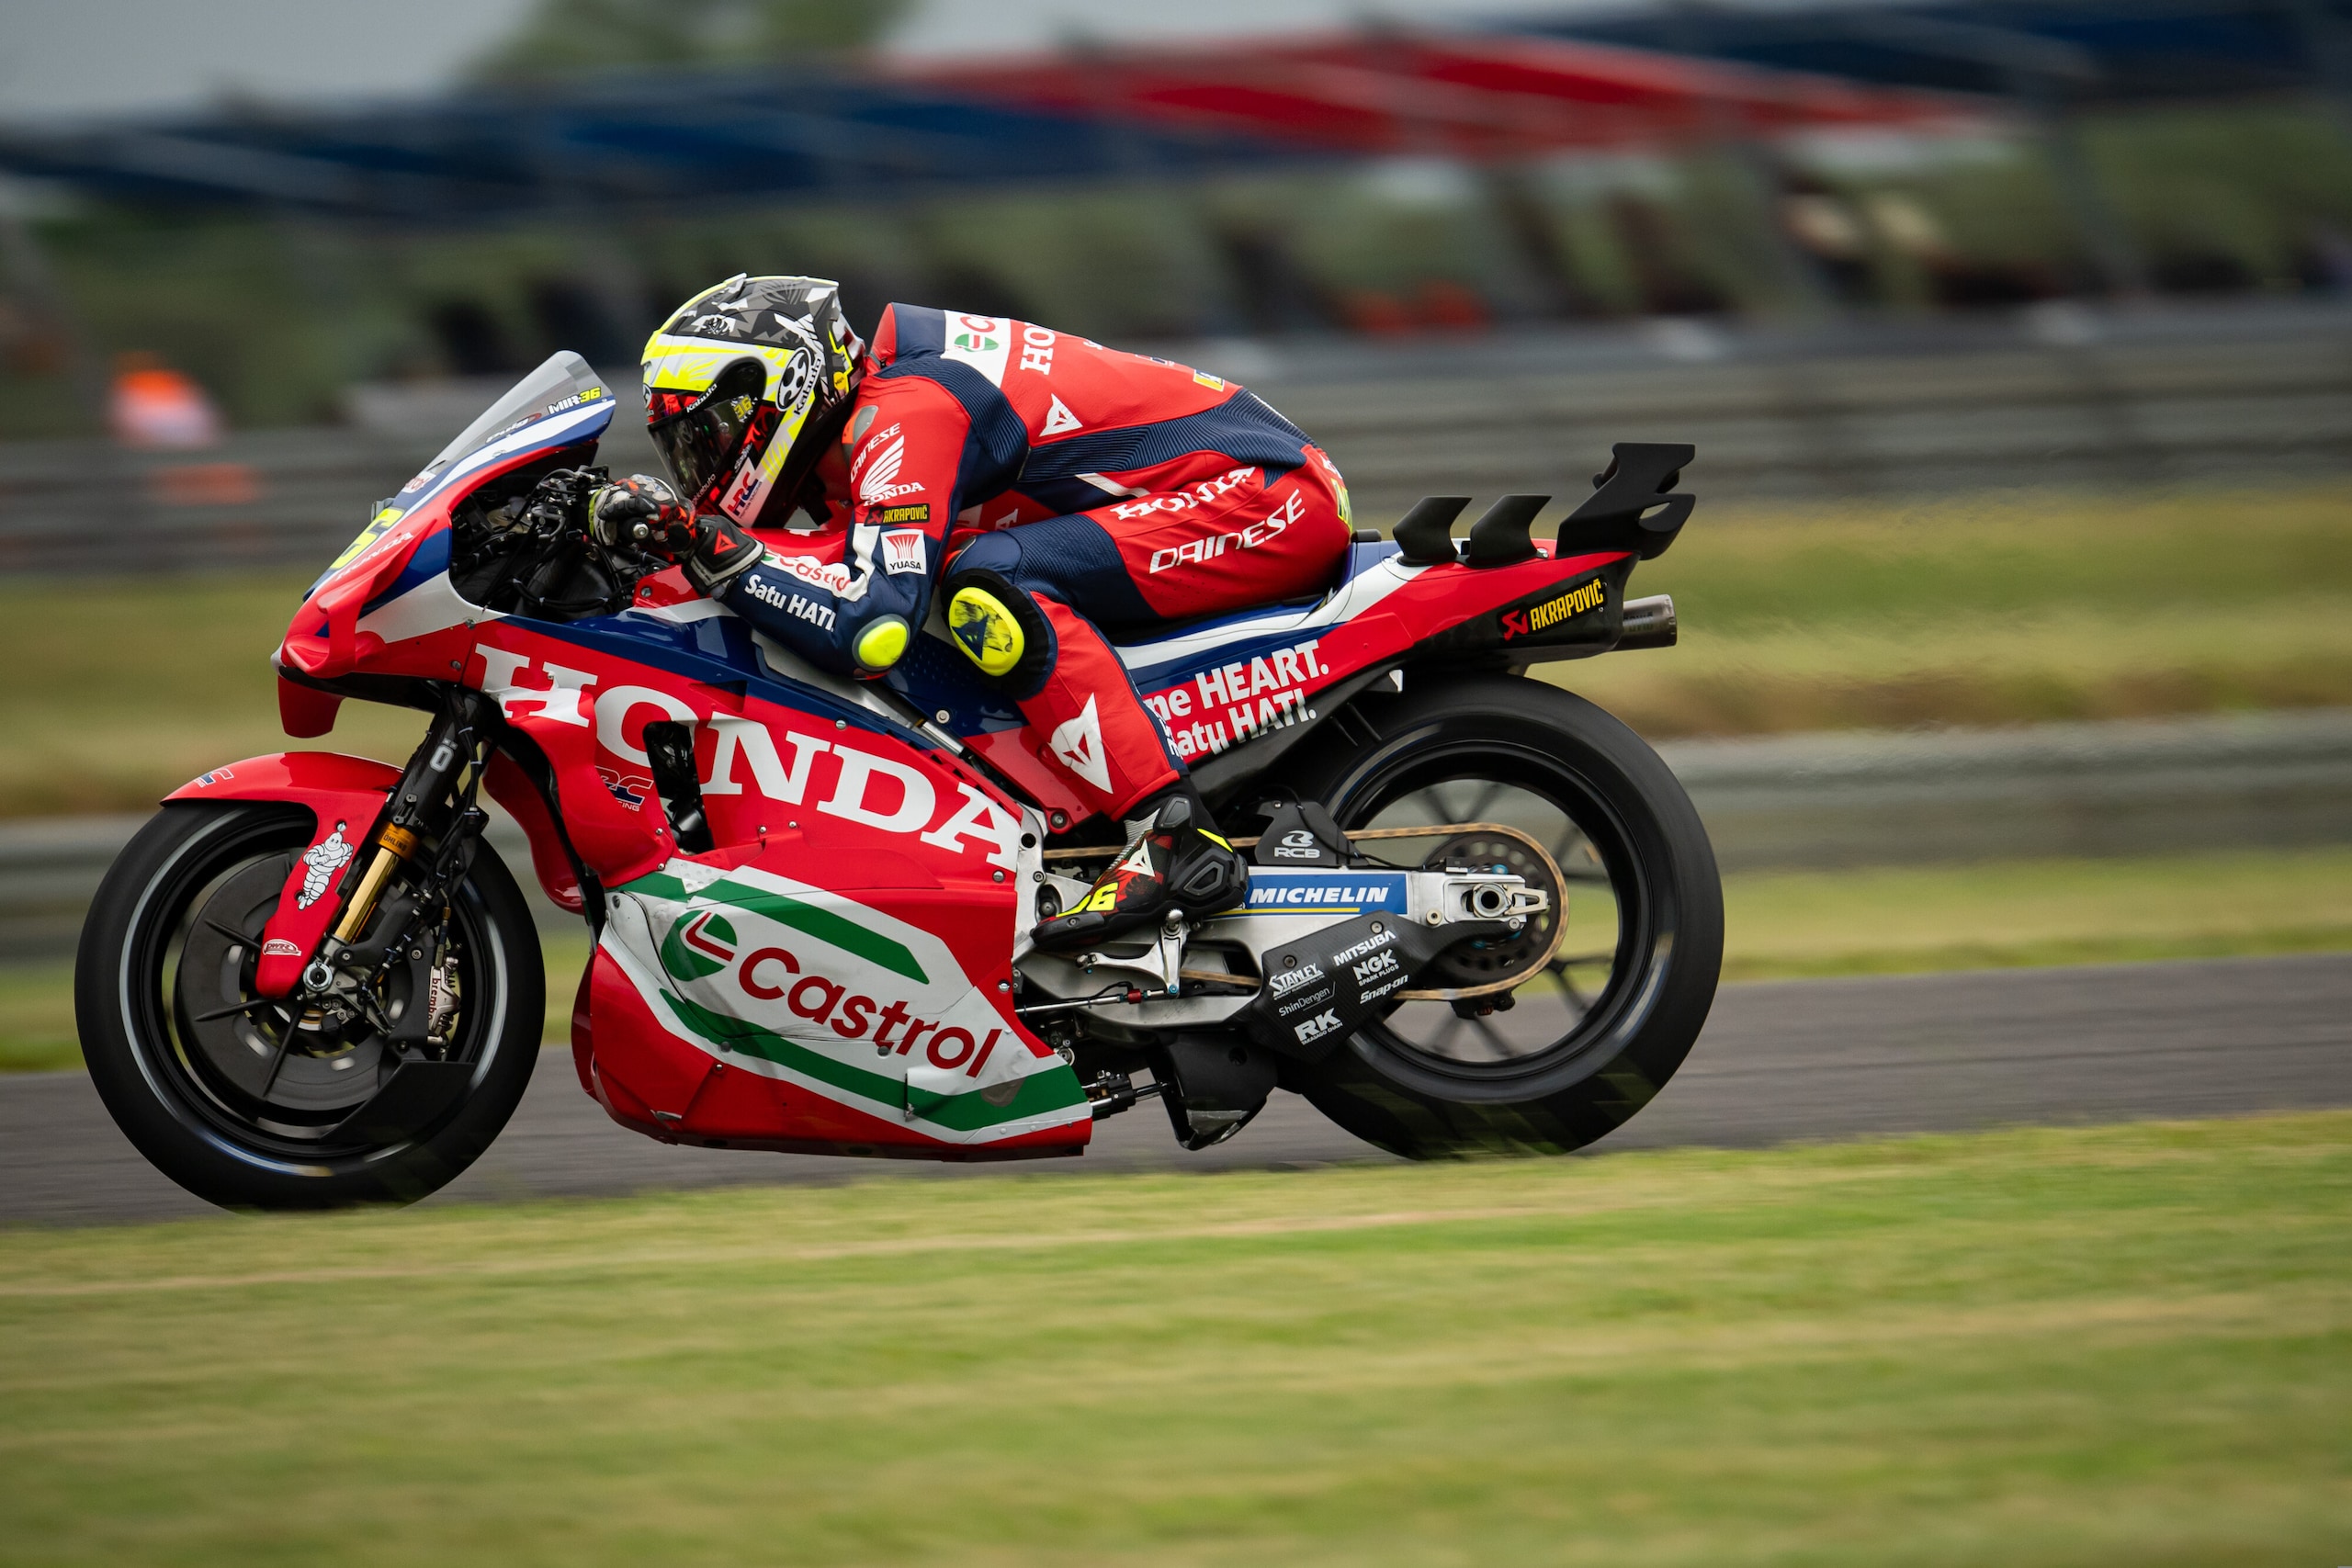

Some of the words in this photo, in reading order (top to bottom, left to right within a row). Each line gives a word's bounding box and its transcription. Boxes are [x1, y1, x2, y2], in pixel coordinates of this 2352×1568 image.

[686, 383, 718, 412] Kabuto
[793, 358, 821, 415] Kabuto
[851, 423, 900, 483] DAINESE
[727, 471, 759, 516] HRC
[1149, 489, 1306, 574] DAINESE
[889, 560, 922, 570] YUASA
[744, 574, 786, 609] Satu
[1143, 689, 1192, 721] ne
[1195, 639, 1329, 709] HEART.
[1177, 721, 1229, 756] atu
[1227, 688, 1317, 743] HATI.
[475, 644, 1020, 872] HONDA
[594, 765, 654, 806] RC
[1273, 847, 1321, 859] RCB
[1250, 886, 1390, 904] MICHELIN
[1333, 930, 1396, 966] MITSUBA
[1352, 949, 1396, 980] NGK
[1269, 963, 1323, 998] STANLEY
[1358, 975, 1380, 987] SPARK
[1379, 964, 1399, 977] PLUGS
[1359, 975, 1409, 1004] Snap-on
[428, 977, 441, 1021] brembo
[739, 947, 1002, 1077] Castrol
[1279, 987, 1330, 1017] ShinDengen
[1295, 1008, 1341, 1043] RK
